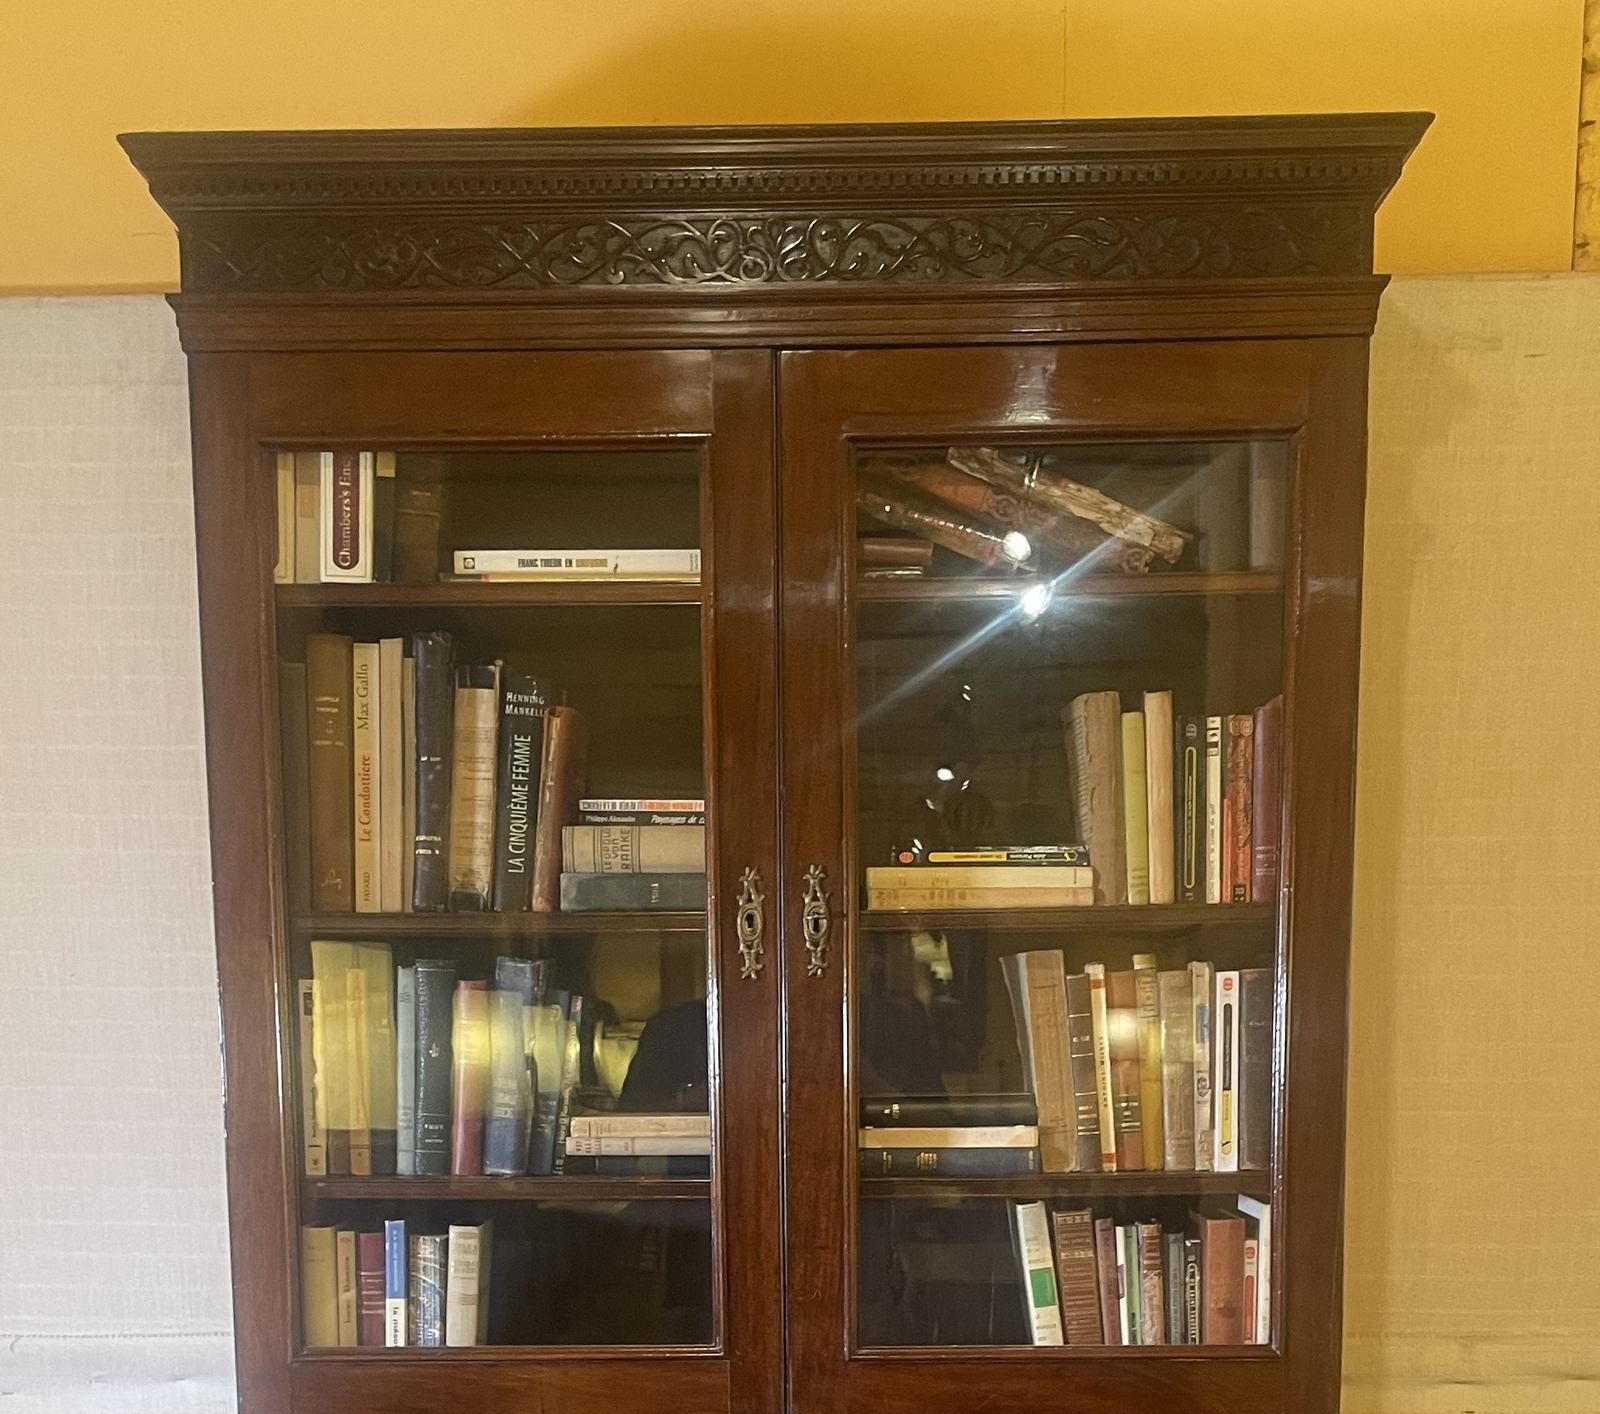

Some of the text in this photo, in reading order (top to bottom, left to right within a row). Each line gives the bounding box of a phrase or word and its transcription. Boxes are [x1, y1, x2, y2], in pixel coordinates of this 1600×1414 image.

[338, 490, 351, 567] Chambers's
[355, 664, 369, 731] Max Gallo
[358, 829, 371, 843] Le
[506, 734, 531, 874] LA CINQUIÈME FEMME
[603, 828, 612, 871] LEOPOLD
